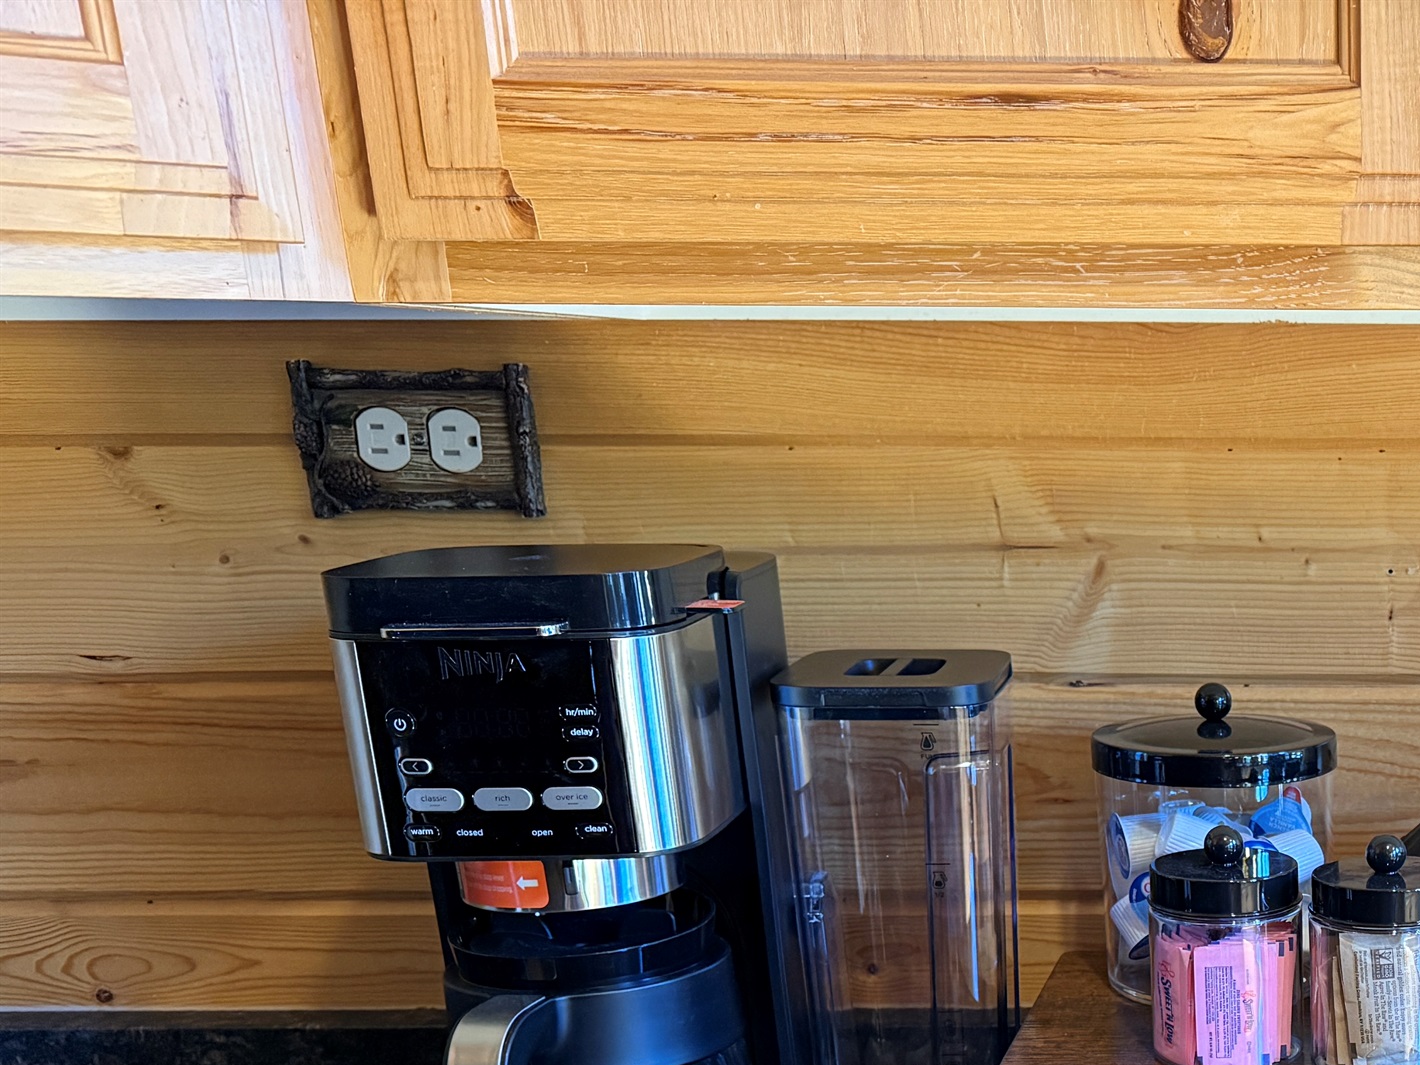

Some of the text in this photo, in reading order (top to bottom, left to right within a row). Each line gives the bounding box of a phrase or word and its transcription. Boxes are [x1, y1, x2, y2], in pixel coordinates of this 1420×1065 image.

[437, 646, 527, 684] NINJA
[564, 707, 594, 717] hr/min
[569, 727, 594, 737] delay
[420, 794, 447, 803] classic
[494, 794, 511, 803] rich
[576, 793, 589, 801] ice
[410, 827, 434, 836] warm
[456, 828, 484, 837] closed
[584, 824, 608, 833] clean
[531, 829, 554, 838] open
